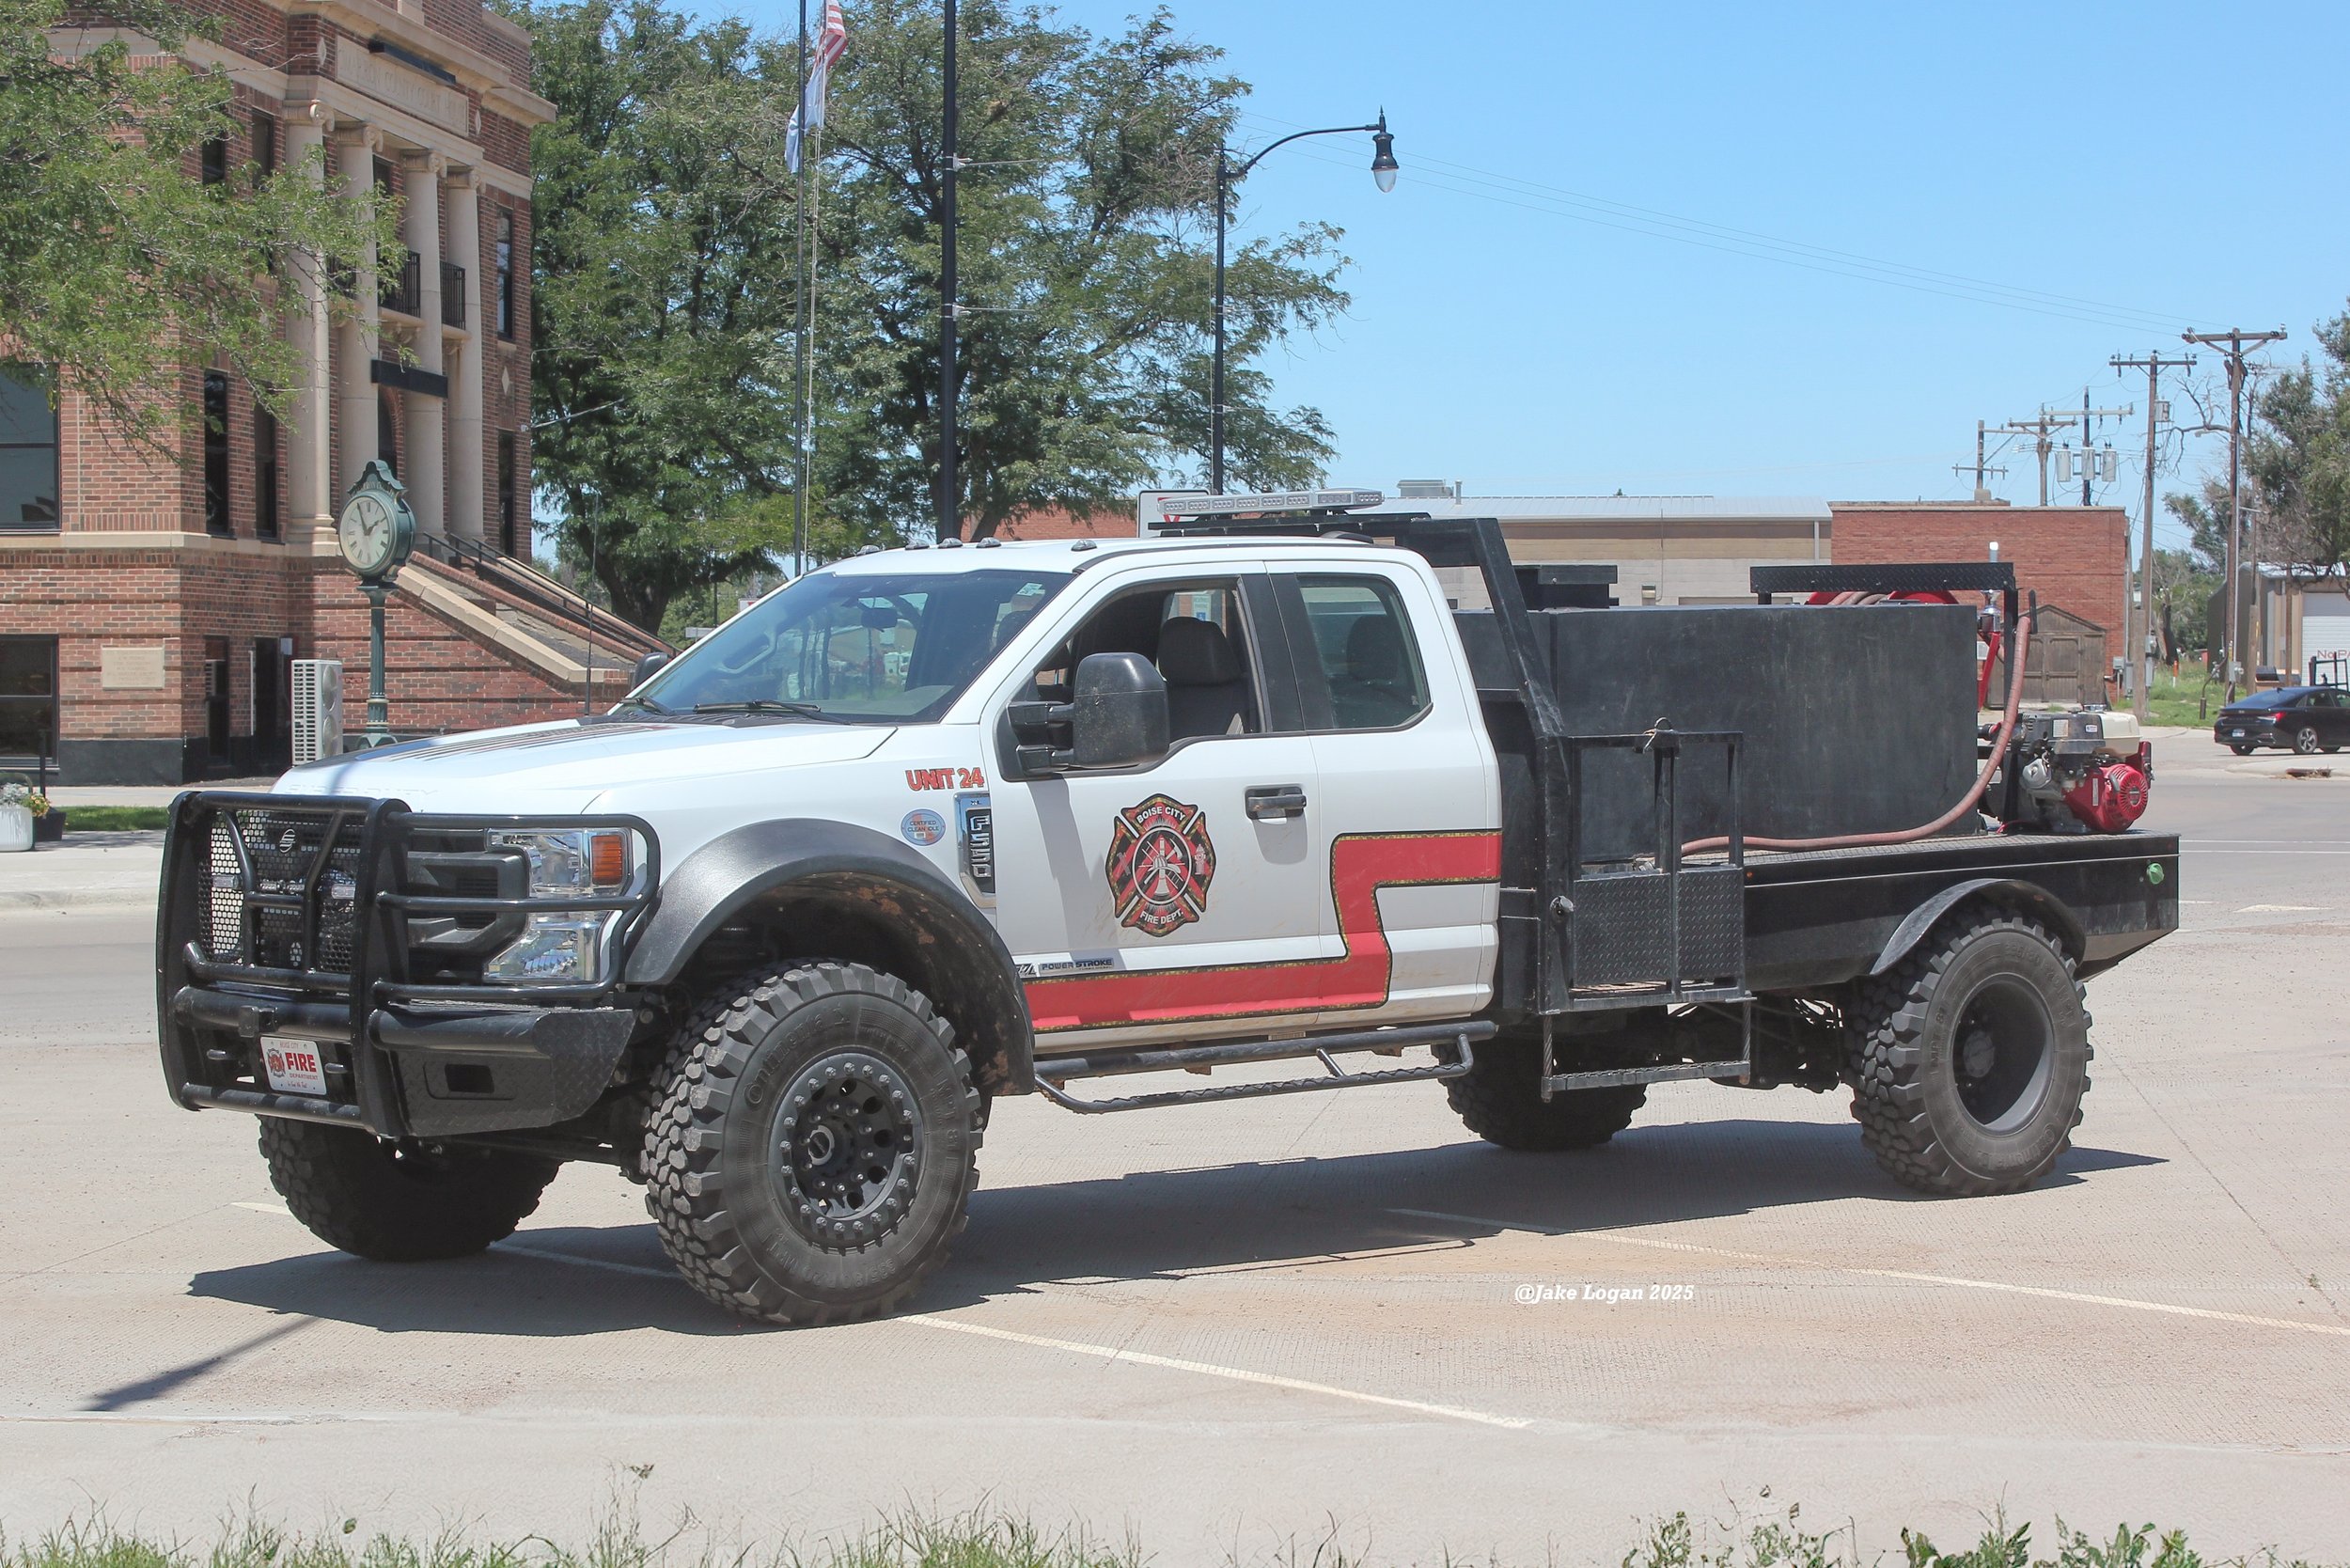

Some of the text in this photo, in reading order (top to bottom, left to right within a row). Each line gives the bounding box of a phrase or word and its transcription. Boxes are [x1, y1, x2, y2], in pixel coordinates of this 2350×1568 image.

[905, 767, 984, 791] UNIT 24
[1136, 806, 1185, 823] BOISE CITY
[1139, 909, 1184, 924] FIRE DEPT.
[1042, 962, 1073, 970] POWER
[1075, 958, 1113, 967] STROKE
[285, 1052, 317, 1073] FIRE
[290, 1073, 318, 1081] DEPARTMENT
